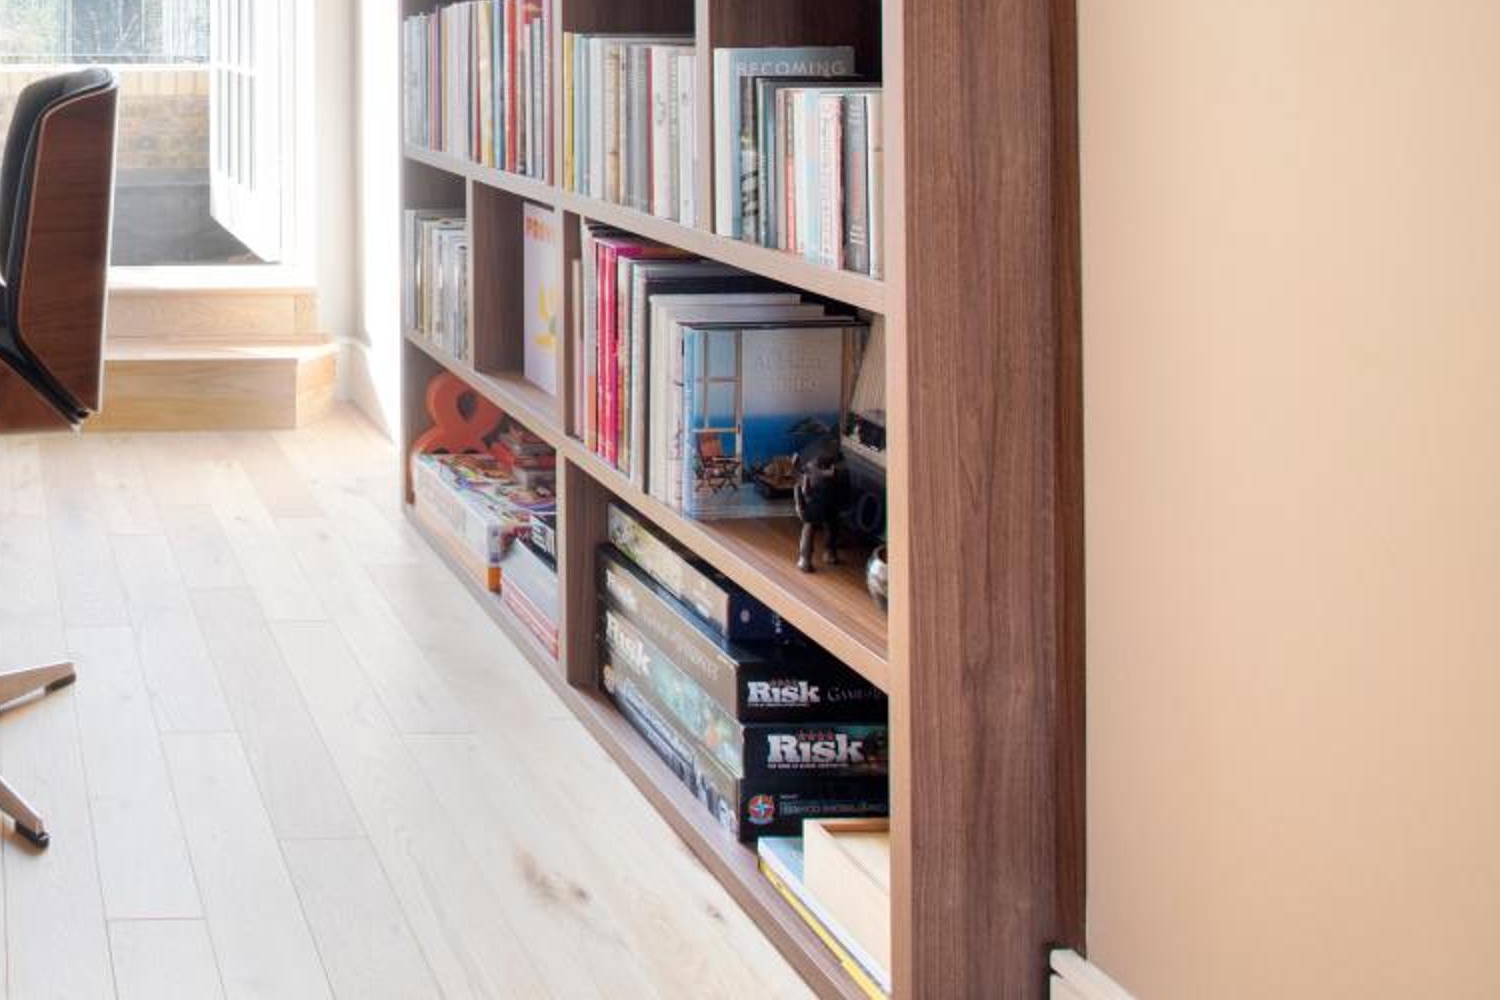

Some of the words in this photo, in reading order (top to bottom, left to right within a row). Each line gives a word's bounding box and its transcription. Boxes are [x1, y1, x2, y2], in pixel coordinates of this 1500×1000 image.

[737, 60, 847, 75] BECOMING
[747, 681, 820, 703] Risk
[767, 733, 866, 763] Risk
